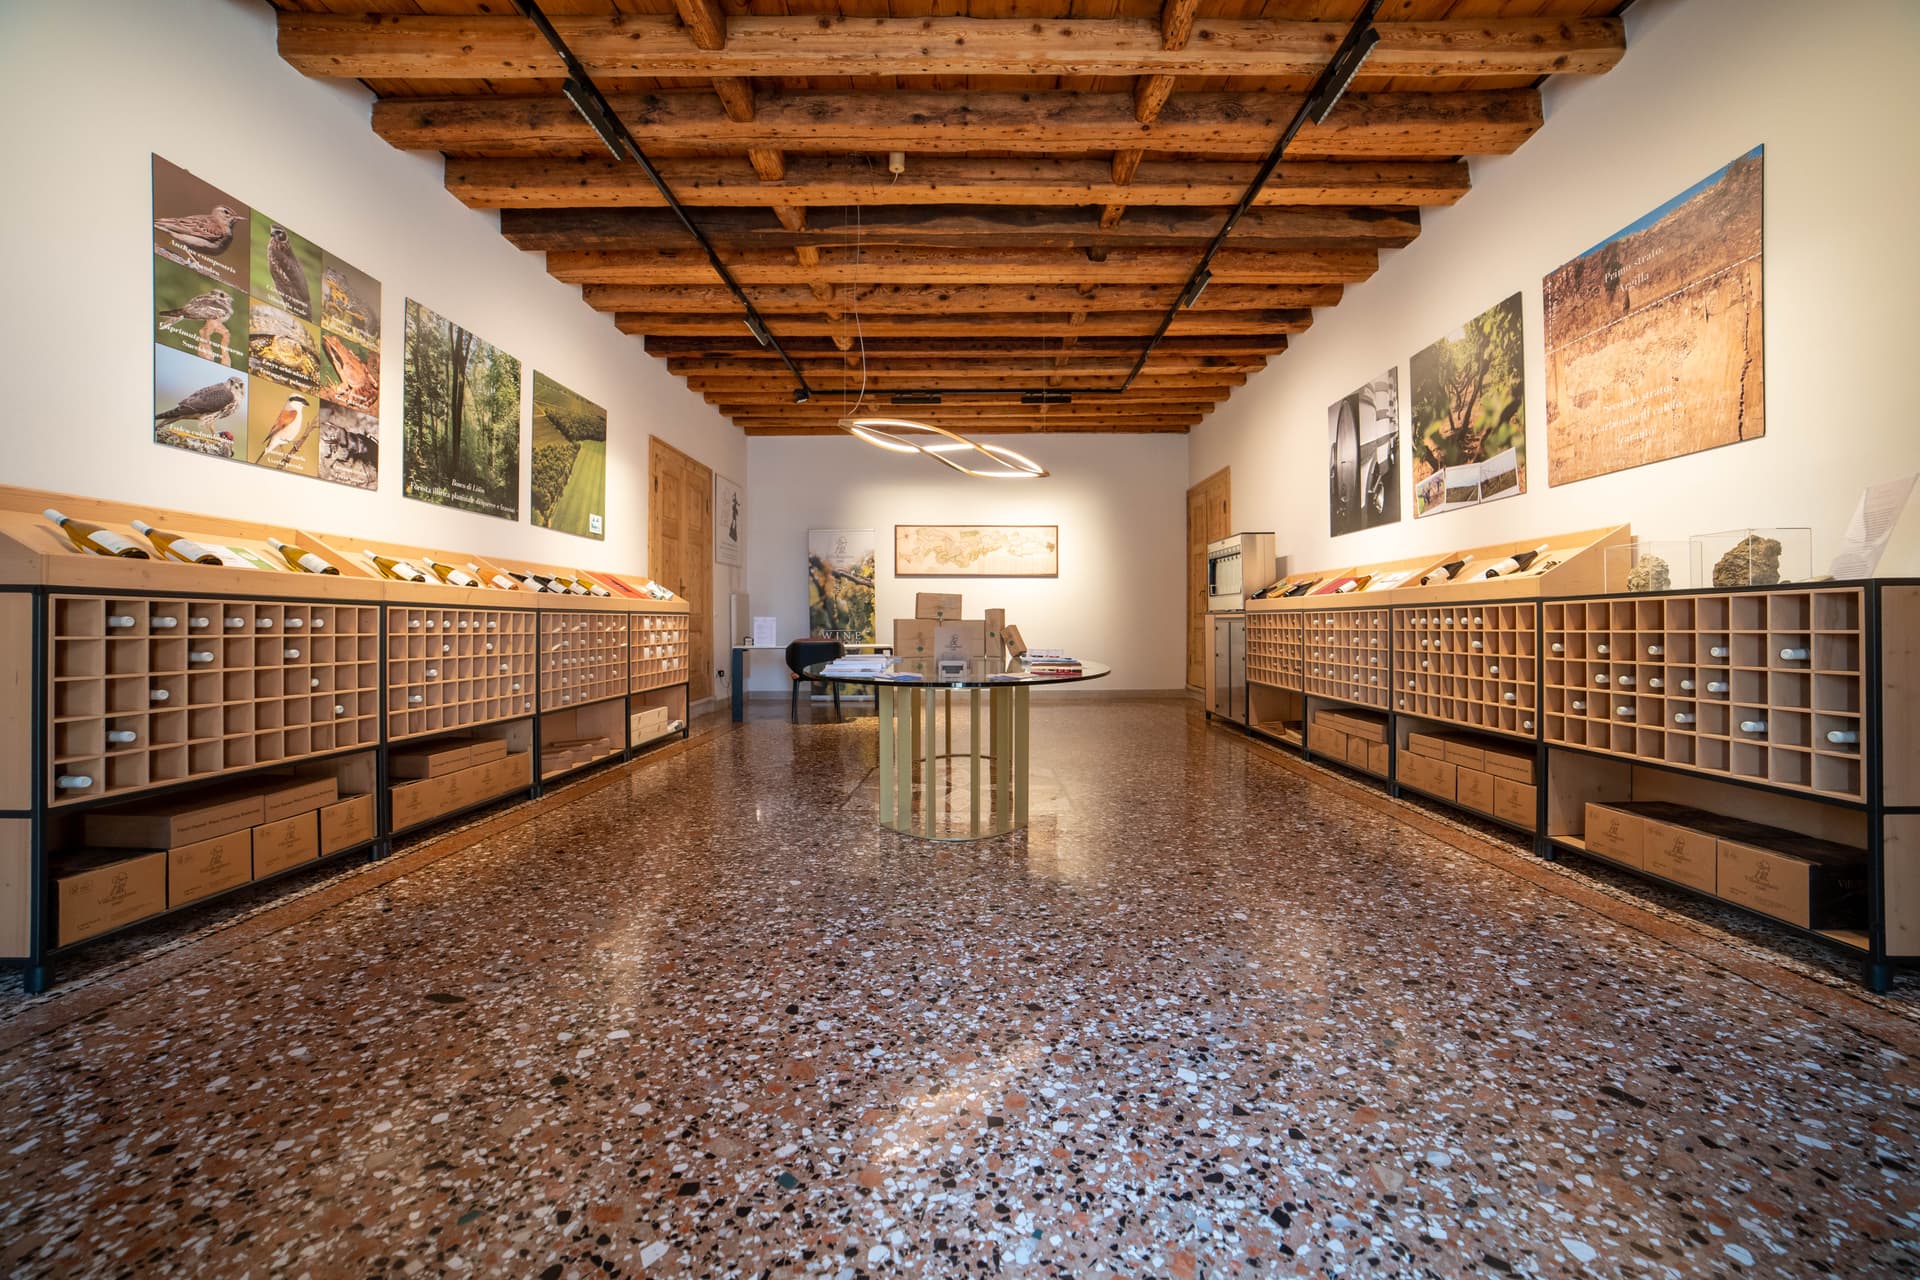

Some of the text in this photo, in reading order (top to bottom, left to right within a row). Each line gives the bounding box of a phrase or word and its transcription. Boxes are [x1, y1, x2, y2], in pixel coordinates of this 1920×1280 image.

[1605, 264, 1632, 284] Primo
[1619, 271, 1649, 293] Argilla
[822, 631, 862, 640] WINE
